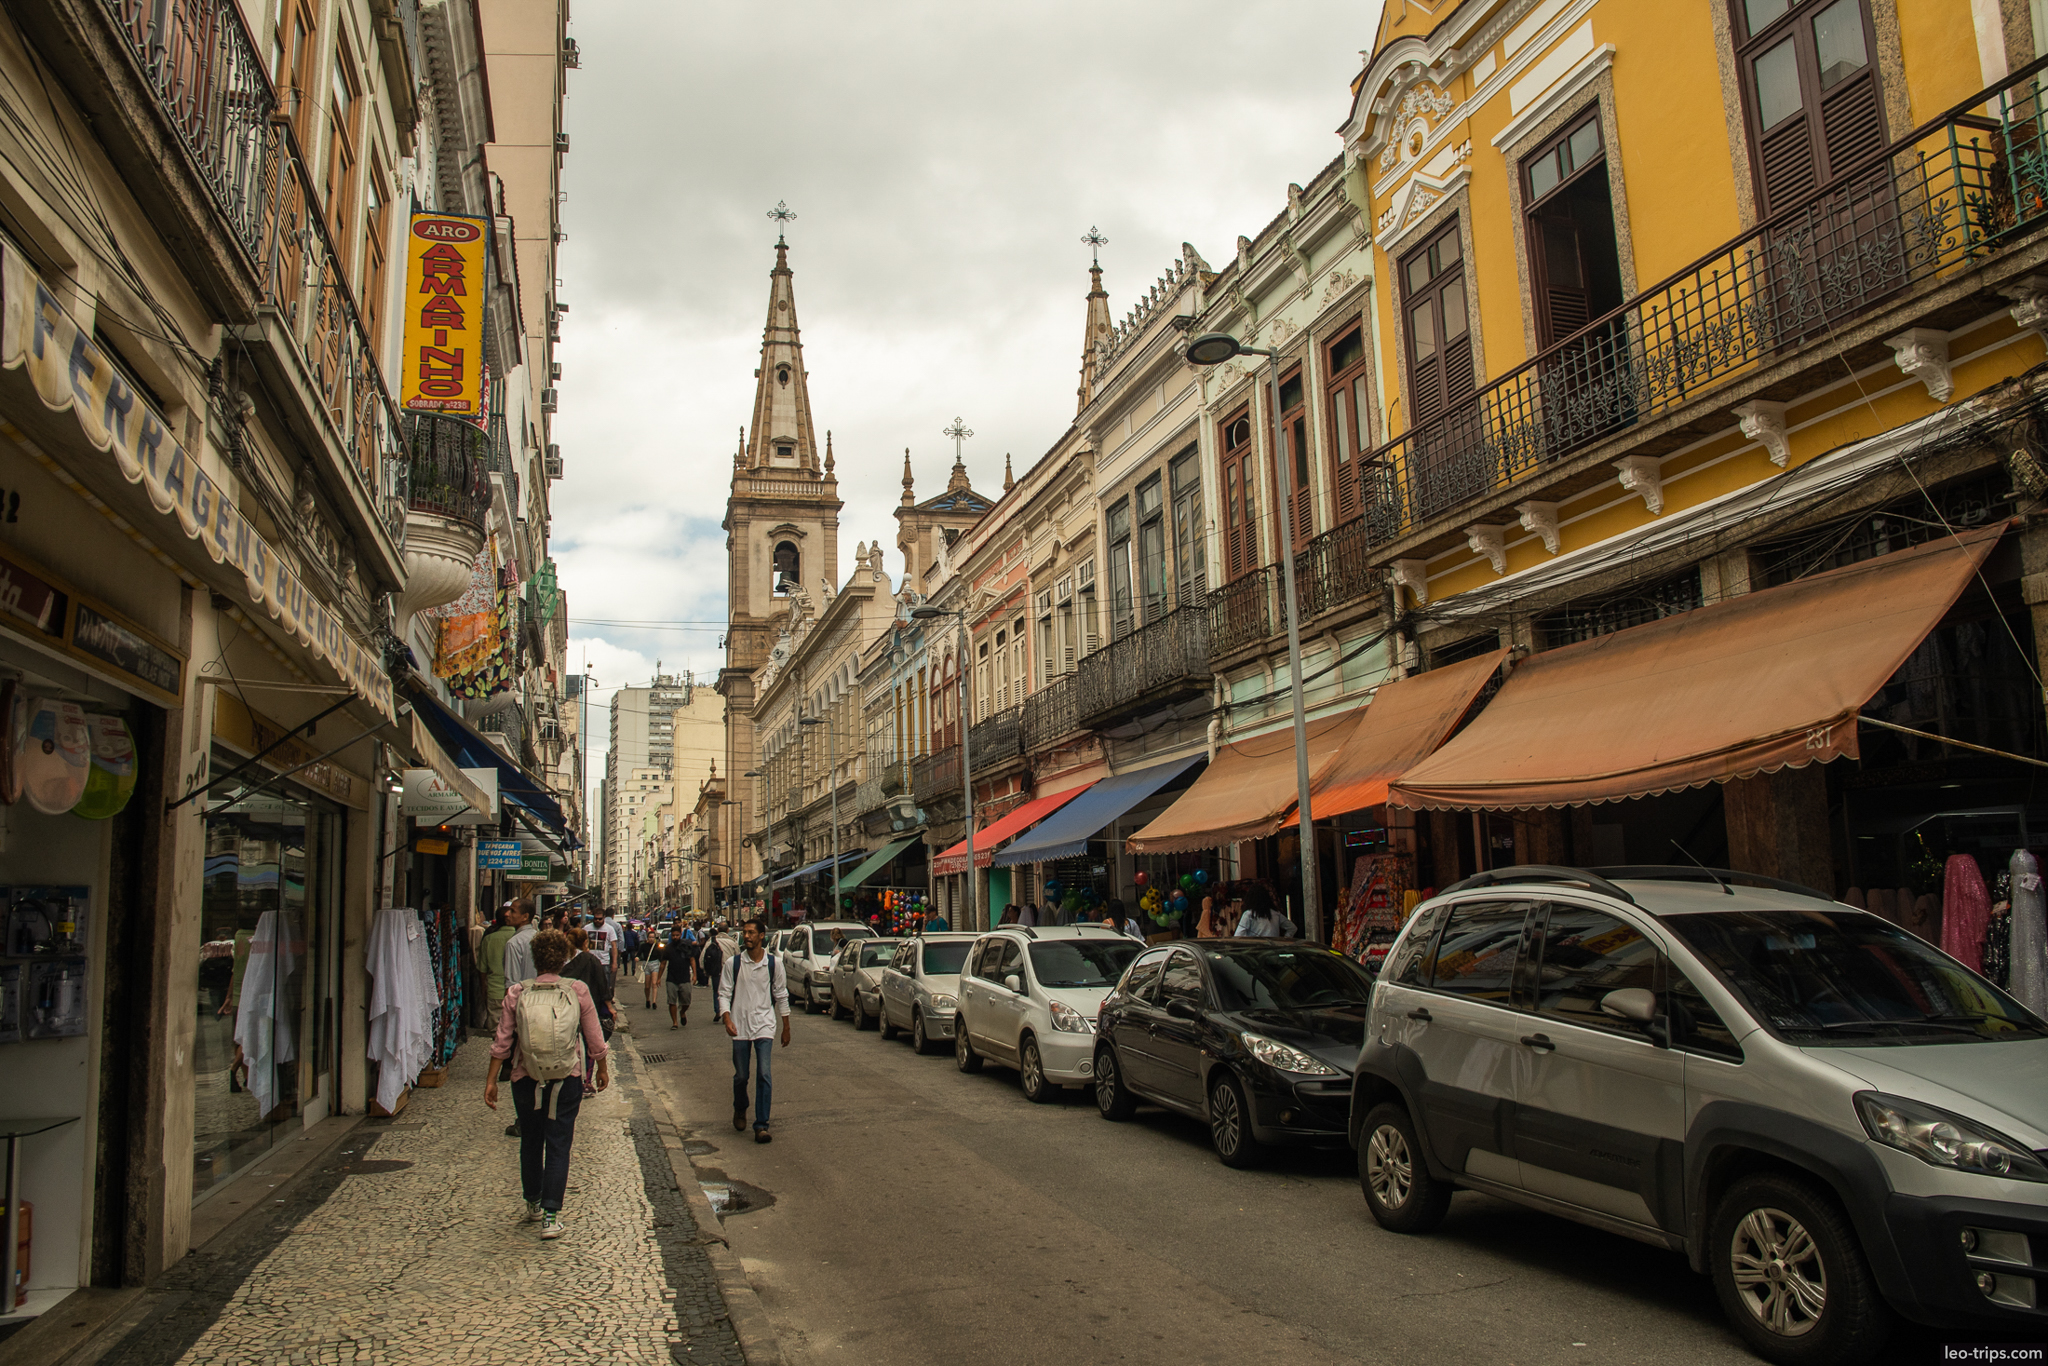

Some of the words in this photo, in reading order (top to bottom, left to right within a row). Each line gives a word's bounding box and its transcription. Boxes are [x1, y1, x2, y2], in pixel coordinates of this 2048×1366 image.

[423, 224, 471, 239] ARO
[419, 243, 468, 398] ARMARINHO
[409, 399, 444, 409] SOBRADO
[32, 279, 268, 585] FERRAGENS
[276, 560, 350, 671] BUENOS
[354, 649, 392, 706] AIRES
[0, 488, 20, 523] 2
[186, 751, 207, 797] 240
[406, 804, 439, 812] TECIDOS
[524, 860, 548, 868] BONITA
